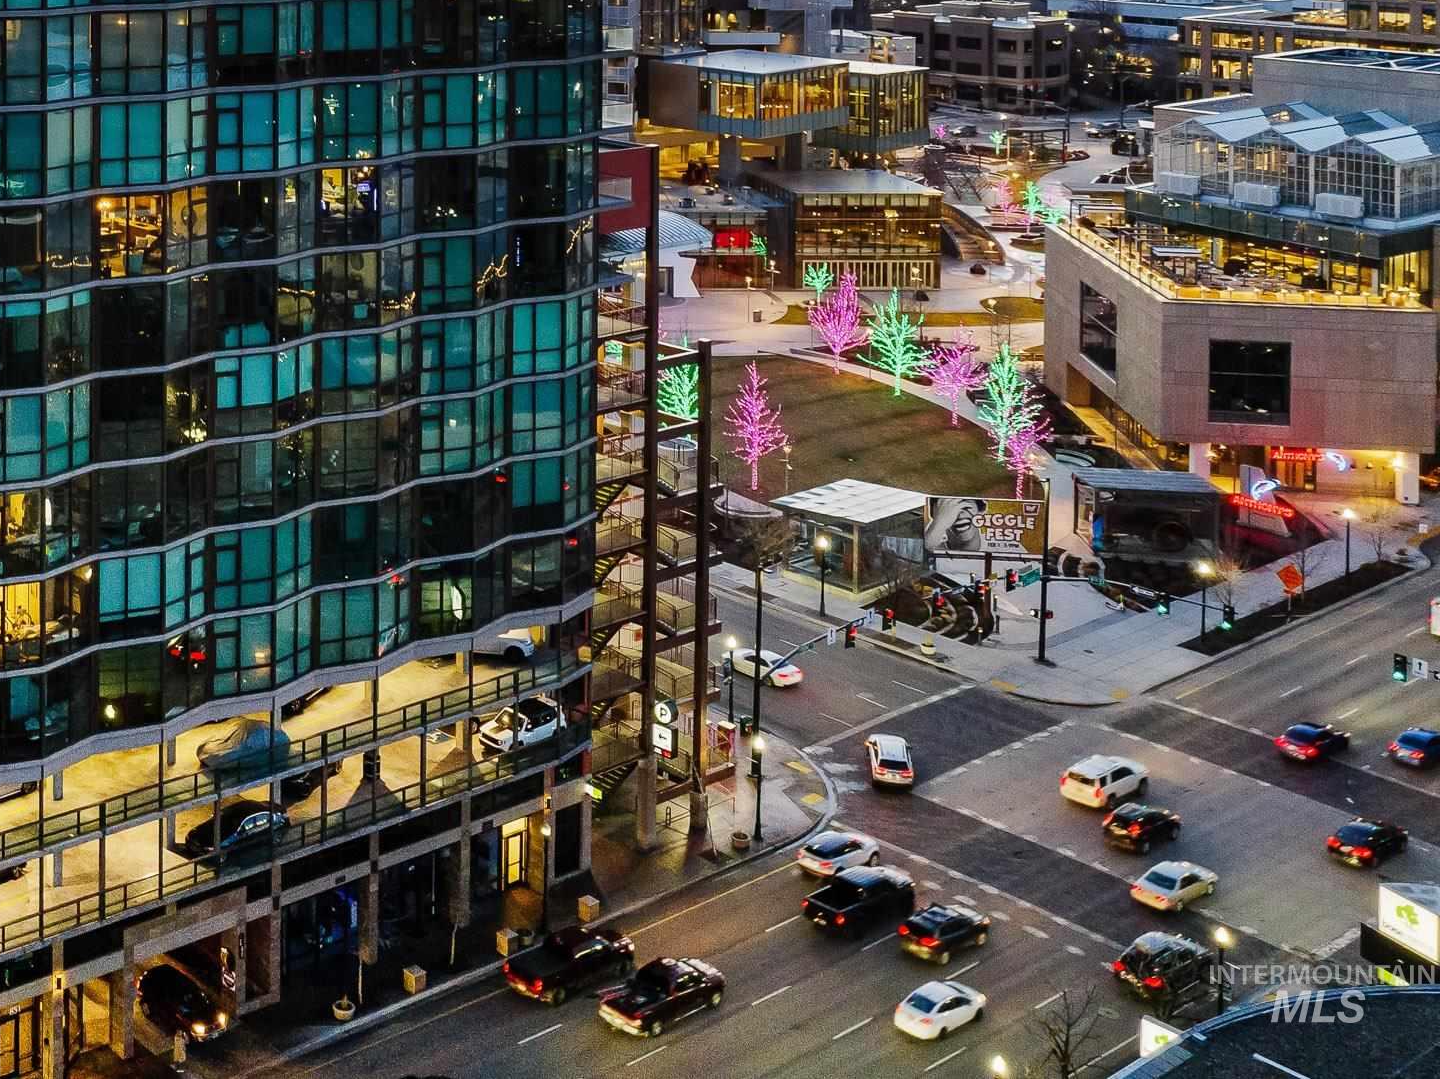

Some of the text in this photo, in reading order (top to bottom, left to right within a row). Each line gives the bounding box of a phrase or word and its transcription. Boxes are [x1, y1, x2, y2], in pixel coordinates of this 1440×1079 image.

[972, 514, 1035, 530] GIGGLE
[986, 528, 1023, 541] FEST
[660, 706, 668, 718] P
